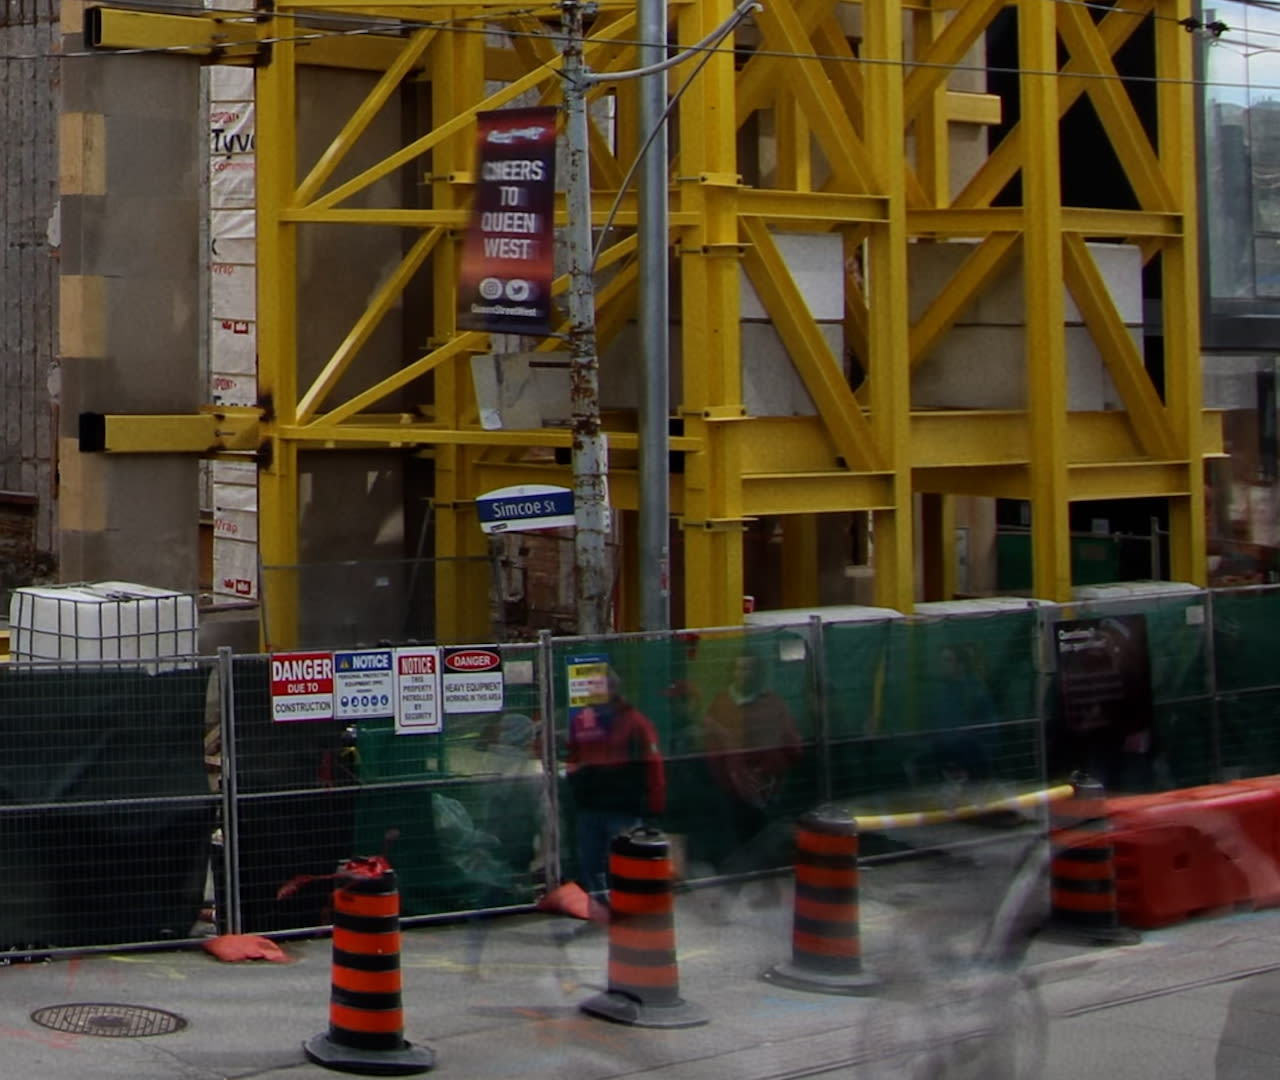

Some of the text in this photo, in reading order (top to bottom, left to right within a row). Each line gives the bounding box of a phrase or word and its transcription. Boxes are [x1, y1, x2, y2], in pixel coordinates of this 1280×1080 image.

[212, 129, 256, 160] Tyv
[483, 160, 544, 181] CHEERS
[498, 186, 519, 206] TO
[481, 212, 536, 233] QUEEN
[484, 238, 532, 259] WEST
[492, 500, 556, 518] Simcoe St
[352, 655, 389, 669] NOTICE
[402, 657, 433, 674] NOTICE
[453, 655, 491, 666] DANGER
[272, 659, 332, 682] DANGER
[287, 682, 319, 694] DUE TO
[403, 684, 432, 692] PROPERTY
[465, 681, 501, 692] EQUIPMENT
[275, 701, 332, 714] CONSTRUCTION
